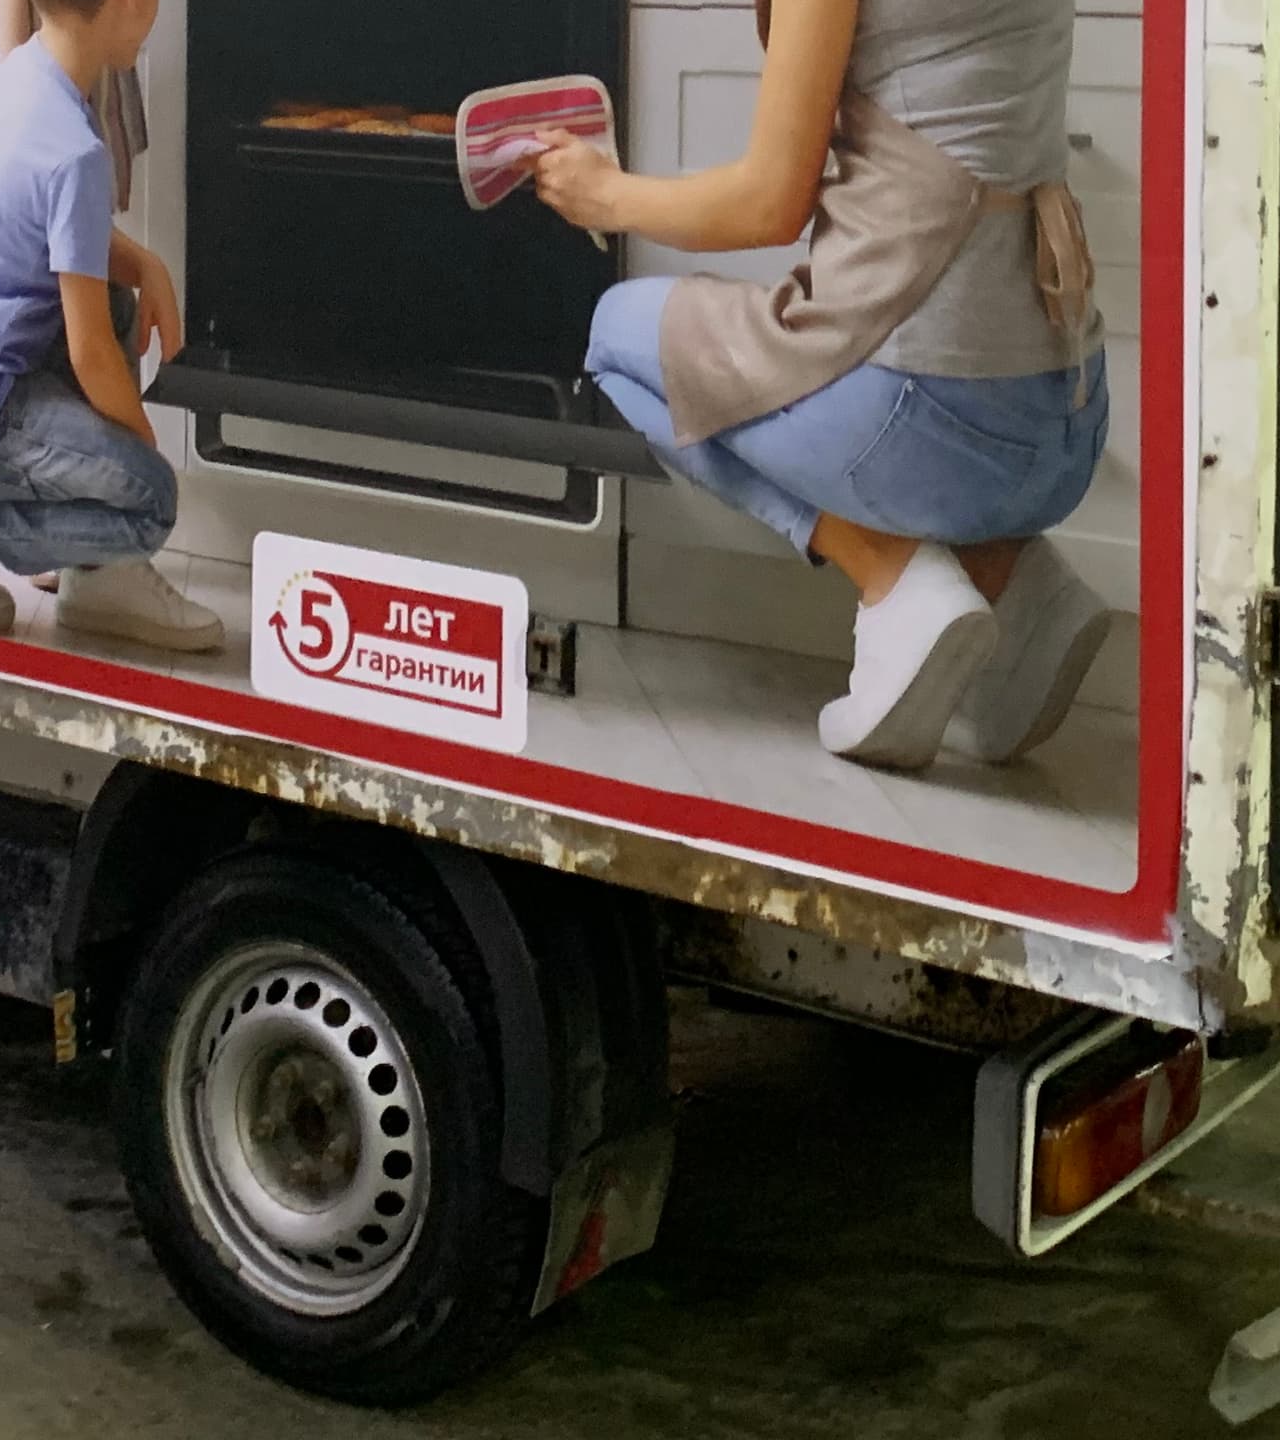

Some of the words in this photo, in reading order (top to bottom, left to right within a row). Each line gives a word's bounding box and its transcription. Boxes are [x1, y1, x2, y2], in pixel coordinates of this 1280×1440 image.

[298, 588, 333, 660] 5
[383, 600, 456, 643] лет
[355, 646, 485, 695] гарантии
